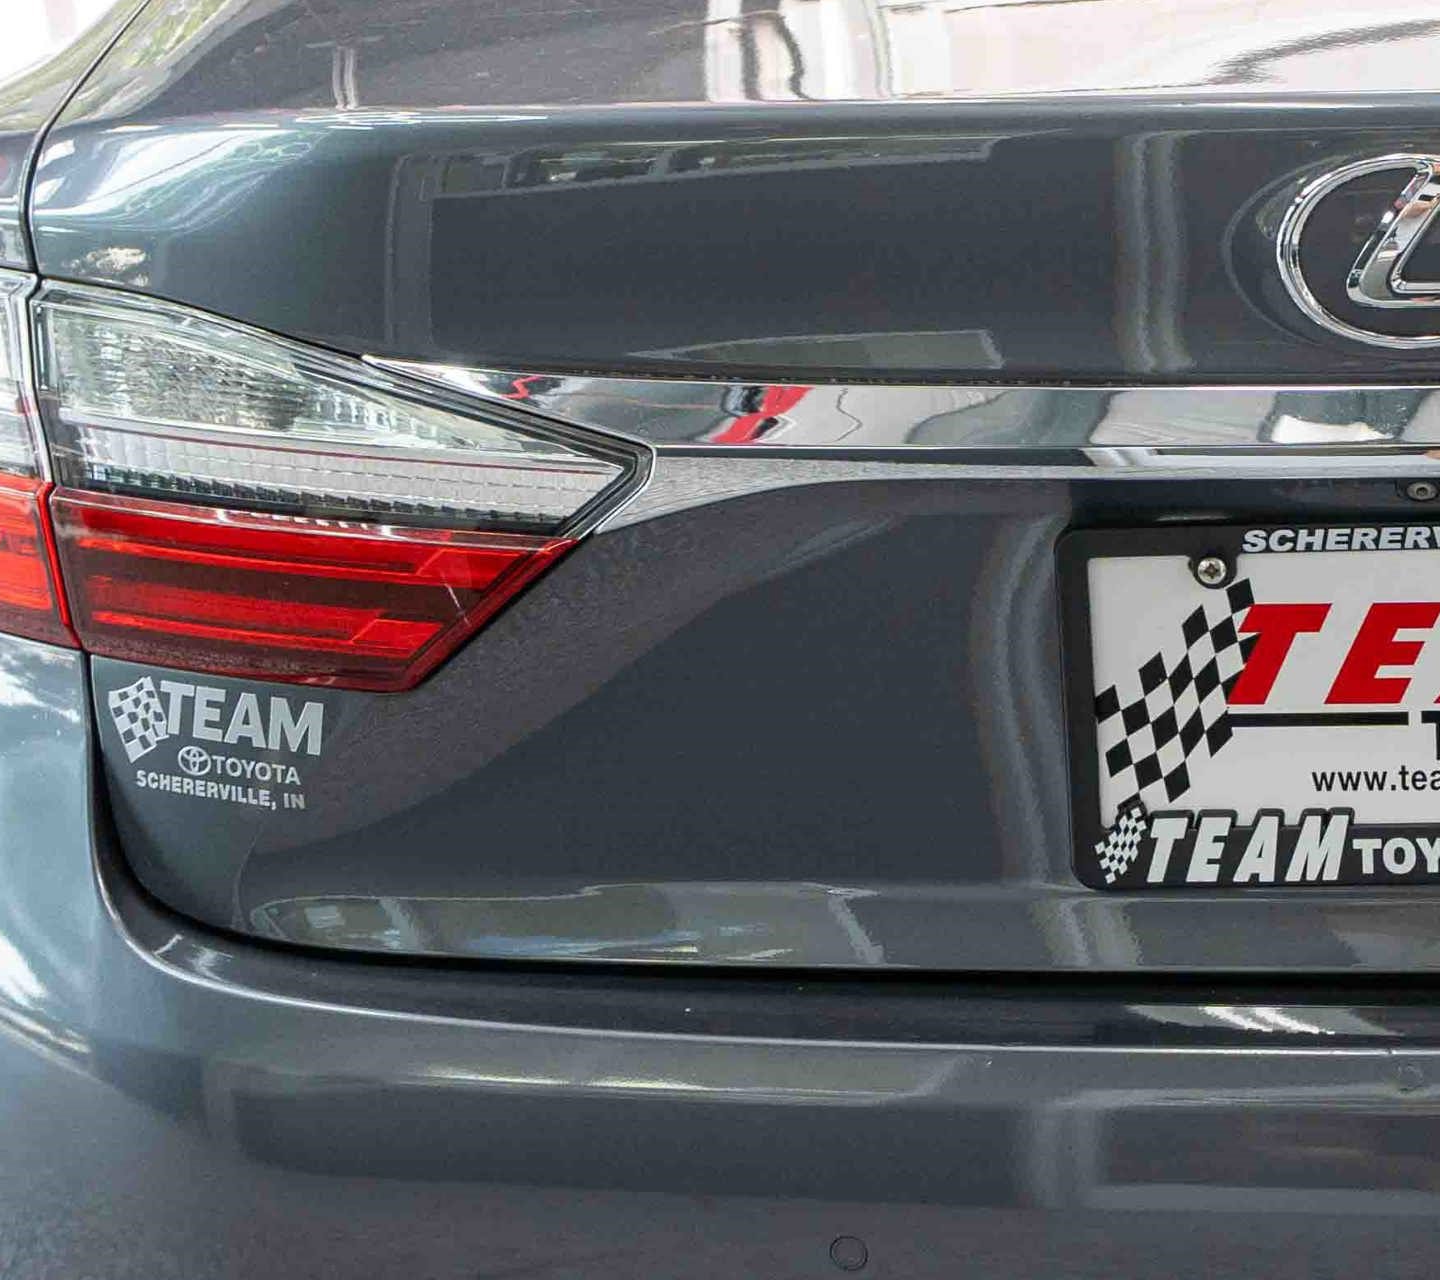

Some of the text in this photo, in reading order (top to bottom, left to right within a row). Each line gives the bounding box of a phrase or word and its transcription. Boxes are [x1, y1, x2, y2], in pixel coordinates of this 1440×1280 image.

[160, 680, 324, 756] TEAM
[135, 770, 306, 811] SCHERERVILLE, IN
[211, 755, 301, 786] TOYOTA
[1147, 810, 1354, 883] TEAM
